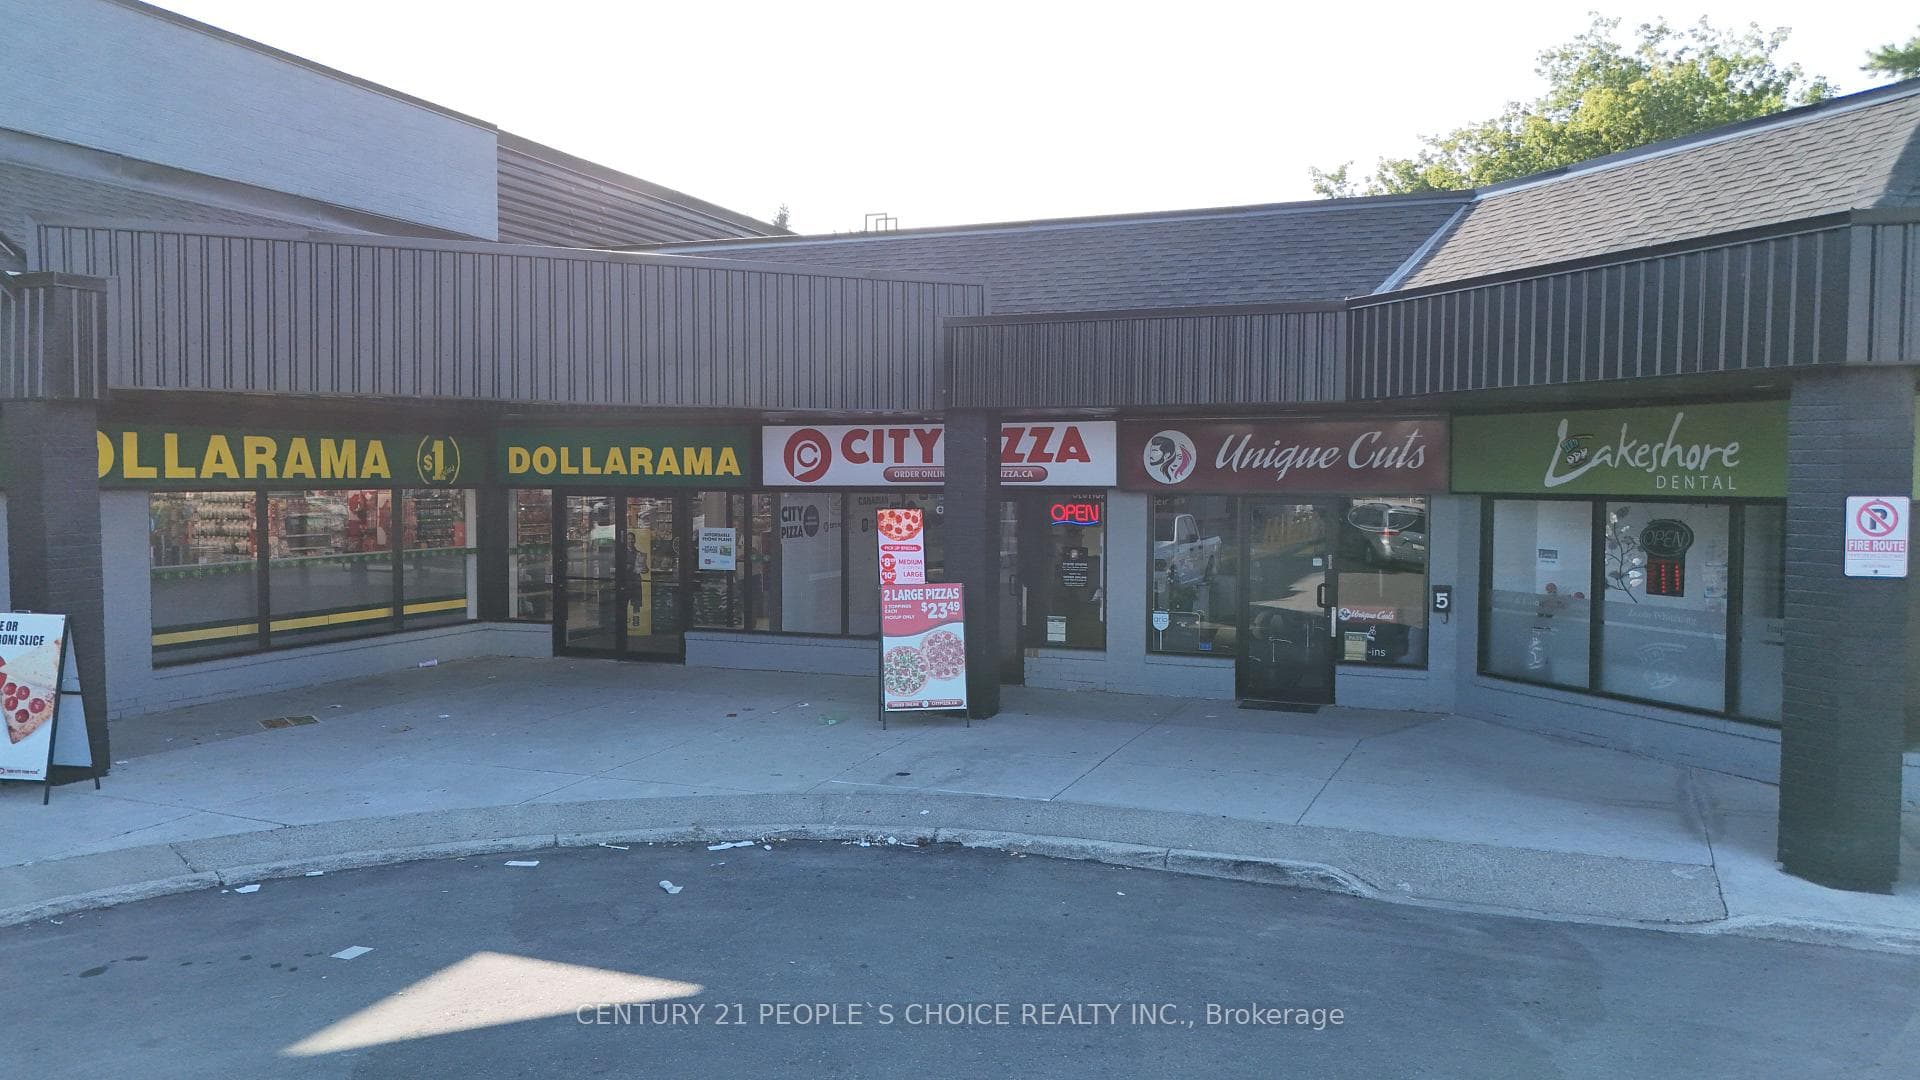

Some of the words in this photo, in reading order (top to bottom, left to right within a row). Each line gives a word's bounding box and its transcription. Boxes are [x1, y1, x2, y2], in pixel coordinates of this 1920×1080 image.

[840, 428, 943, 464] CITY
[1000, 426, 1091, 463] ZZA
[1544, 411, 1740, 488] Lakeshore
[96, 431, 391, 479] LLARAMA
[508, 447, 741, 476] DOLLARAMA
[1215, 434, 1342, 482] Unique
[1347, 428, 1426, 469] Cuts
[894, 470, 920, 478] ORDER
[921, 470, 945, 478] ONLIN
[1656, 475, 1737, 490] DENTAL
[781, 505, 803, 522] CITY
[1050, 503, 1099, 521] OPEN
[781, 525, 804, 538] PIZZA
[1644, 530, 1687, 549] OPEN
[1848, 541, 1870, 551] FIRE
[1872, 541, 1905, 551] ROUTE
[883, 589, 890, 601] 2
[892, 589, 924, 601] LARGE
[1435, 592, 1449, 609] 5
[1351, 609, 1377, 621] Unique
[1377, 611, 1395, 620] Cuts
[5, 620, 19, 632] OR
[18, 634, 45, 647] SLICE
[1367, 648, 1386, 657] -ins
